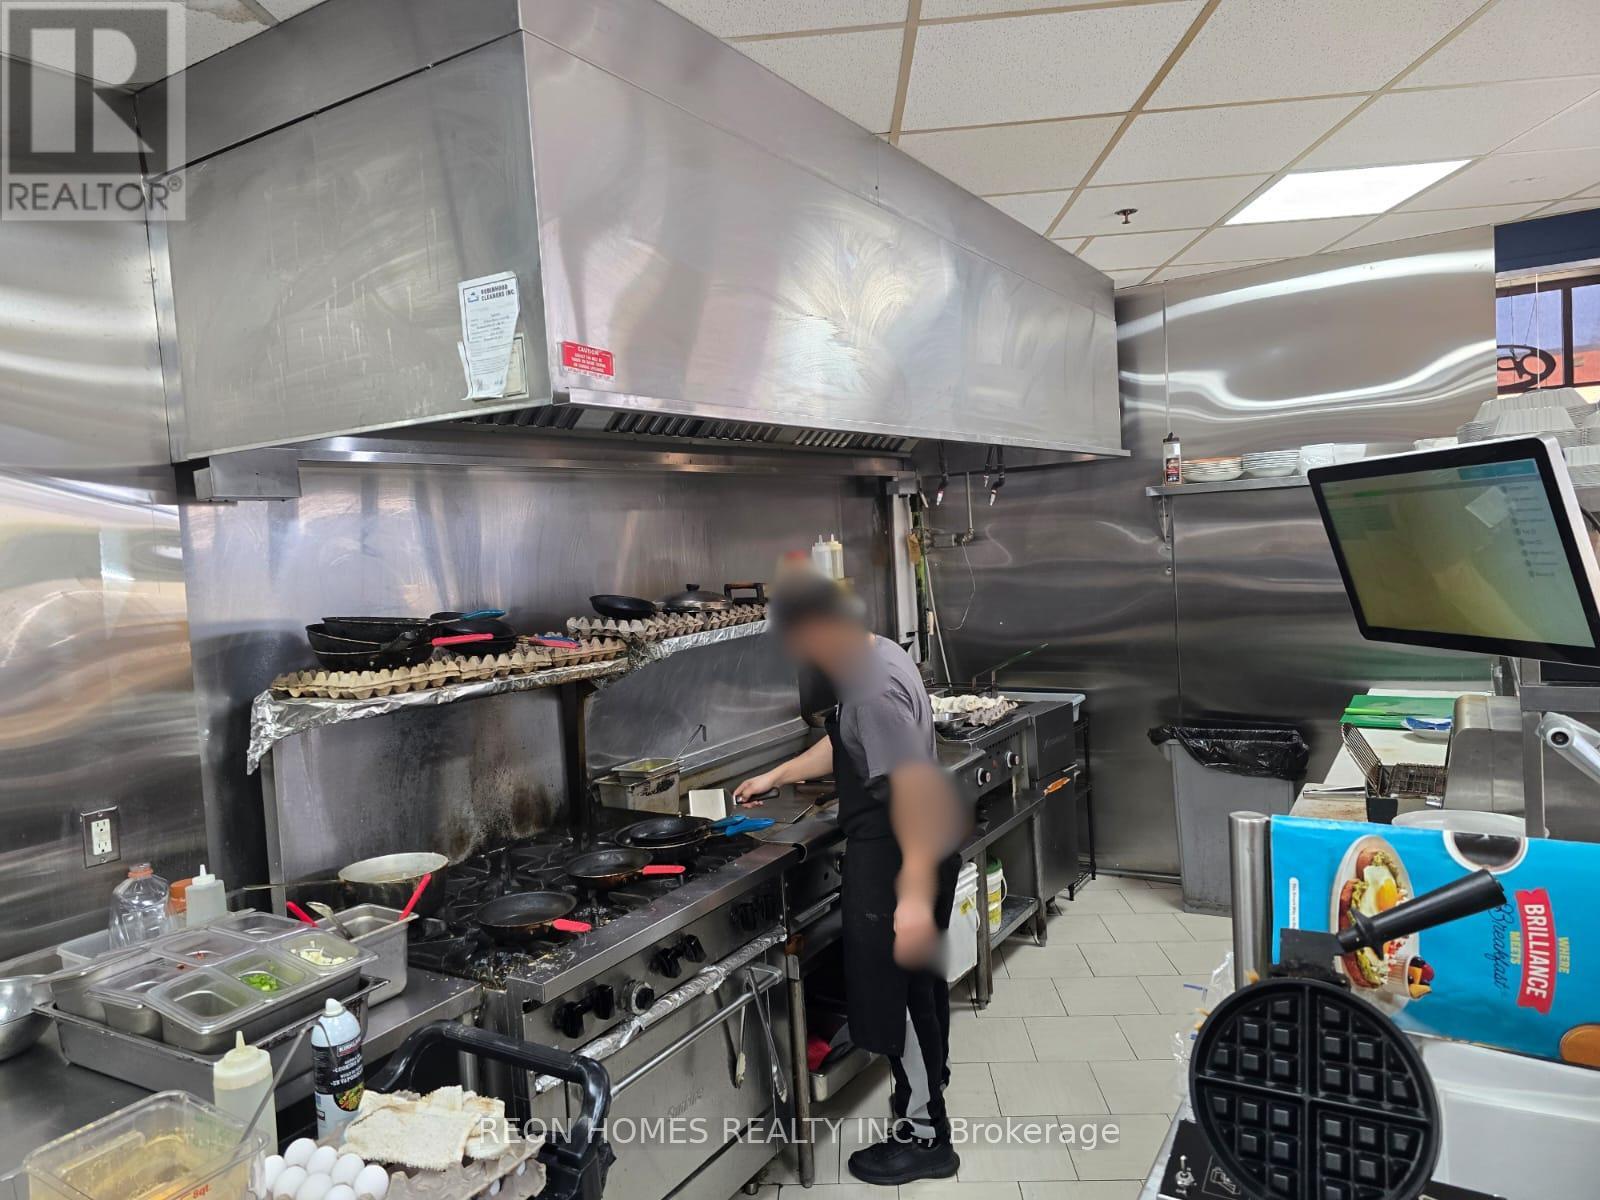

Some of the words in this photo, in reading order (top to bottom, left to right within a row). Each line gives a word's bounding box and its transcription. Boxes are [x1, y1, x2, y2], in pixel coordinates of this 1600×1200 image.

[1484, 903, 1514, 991] Breakfast
[1509, 930, 1522, 965] MEETS
[1524, 904, 1550, 999] BRILLIANCE
[1558, 936, 1570, 974] WHERE
